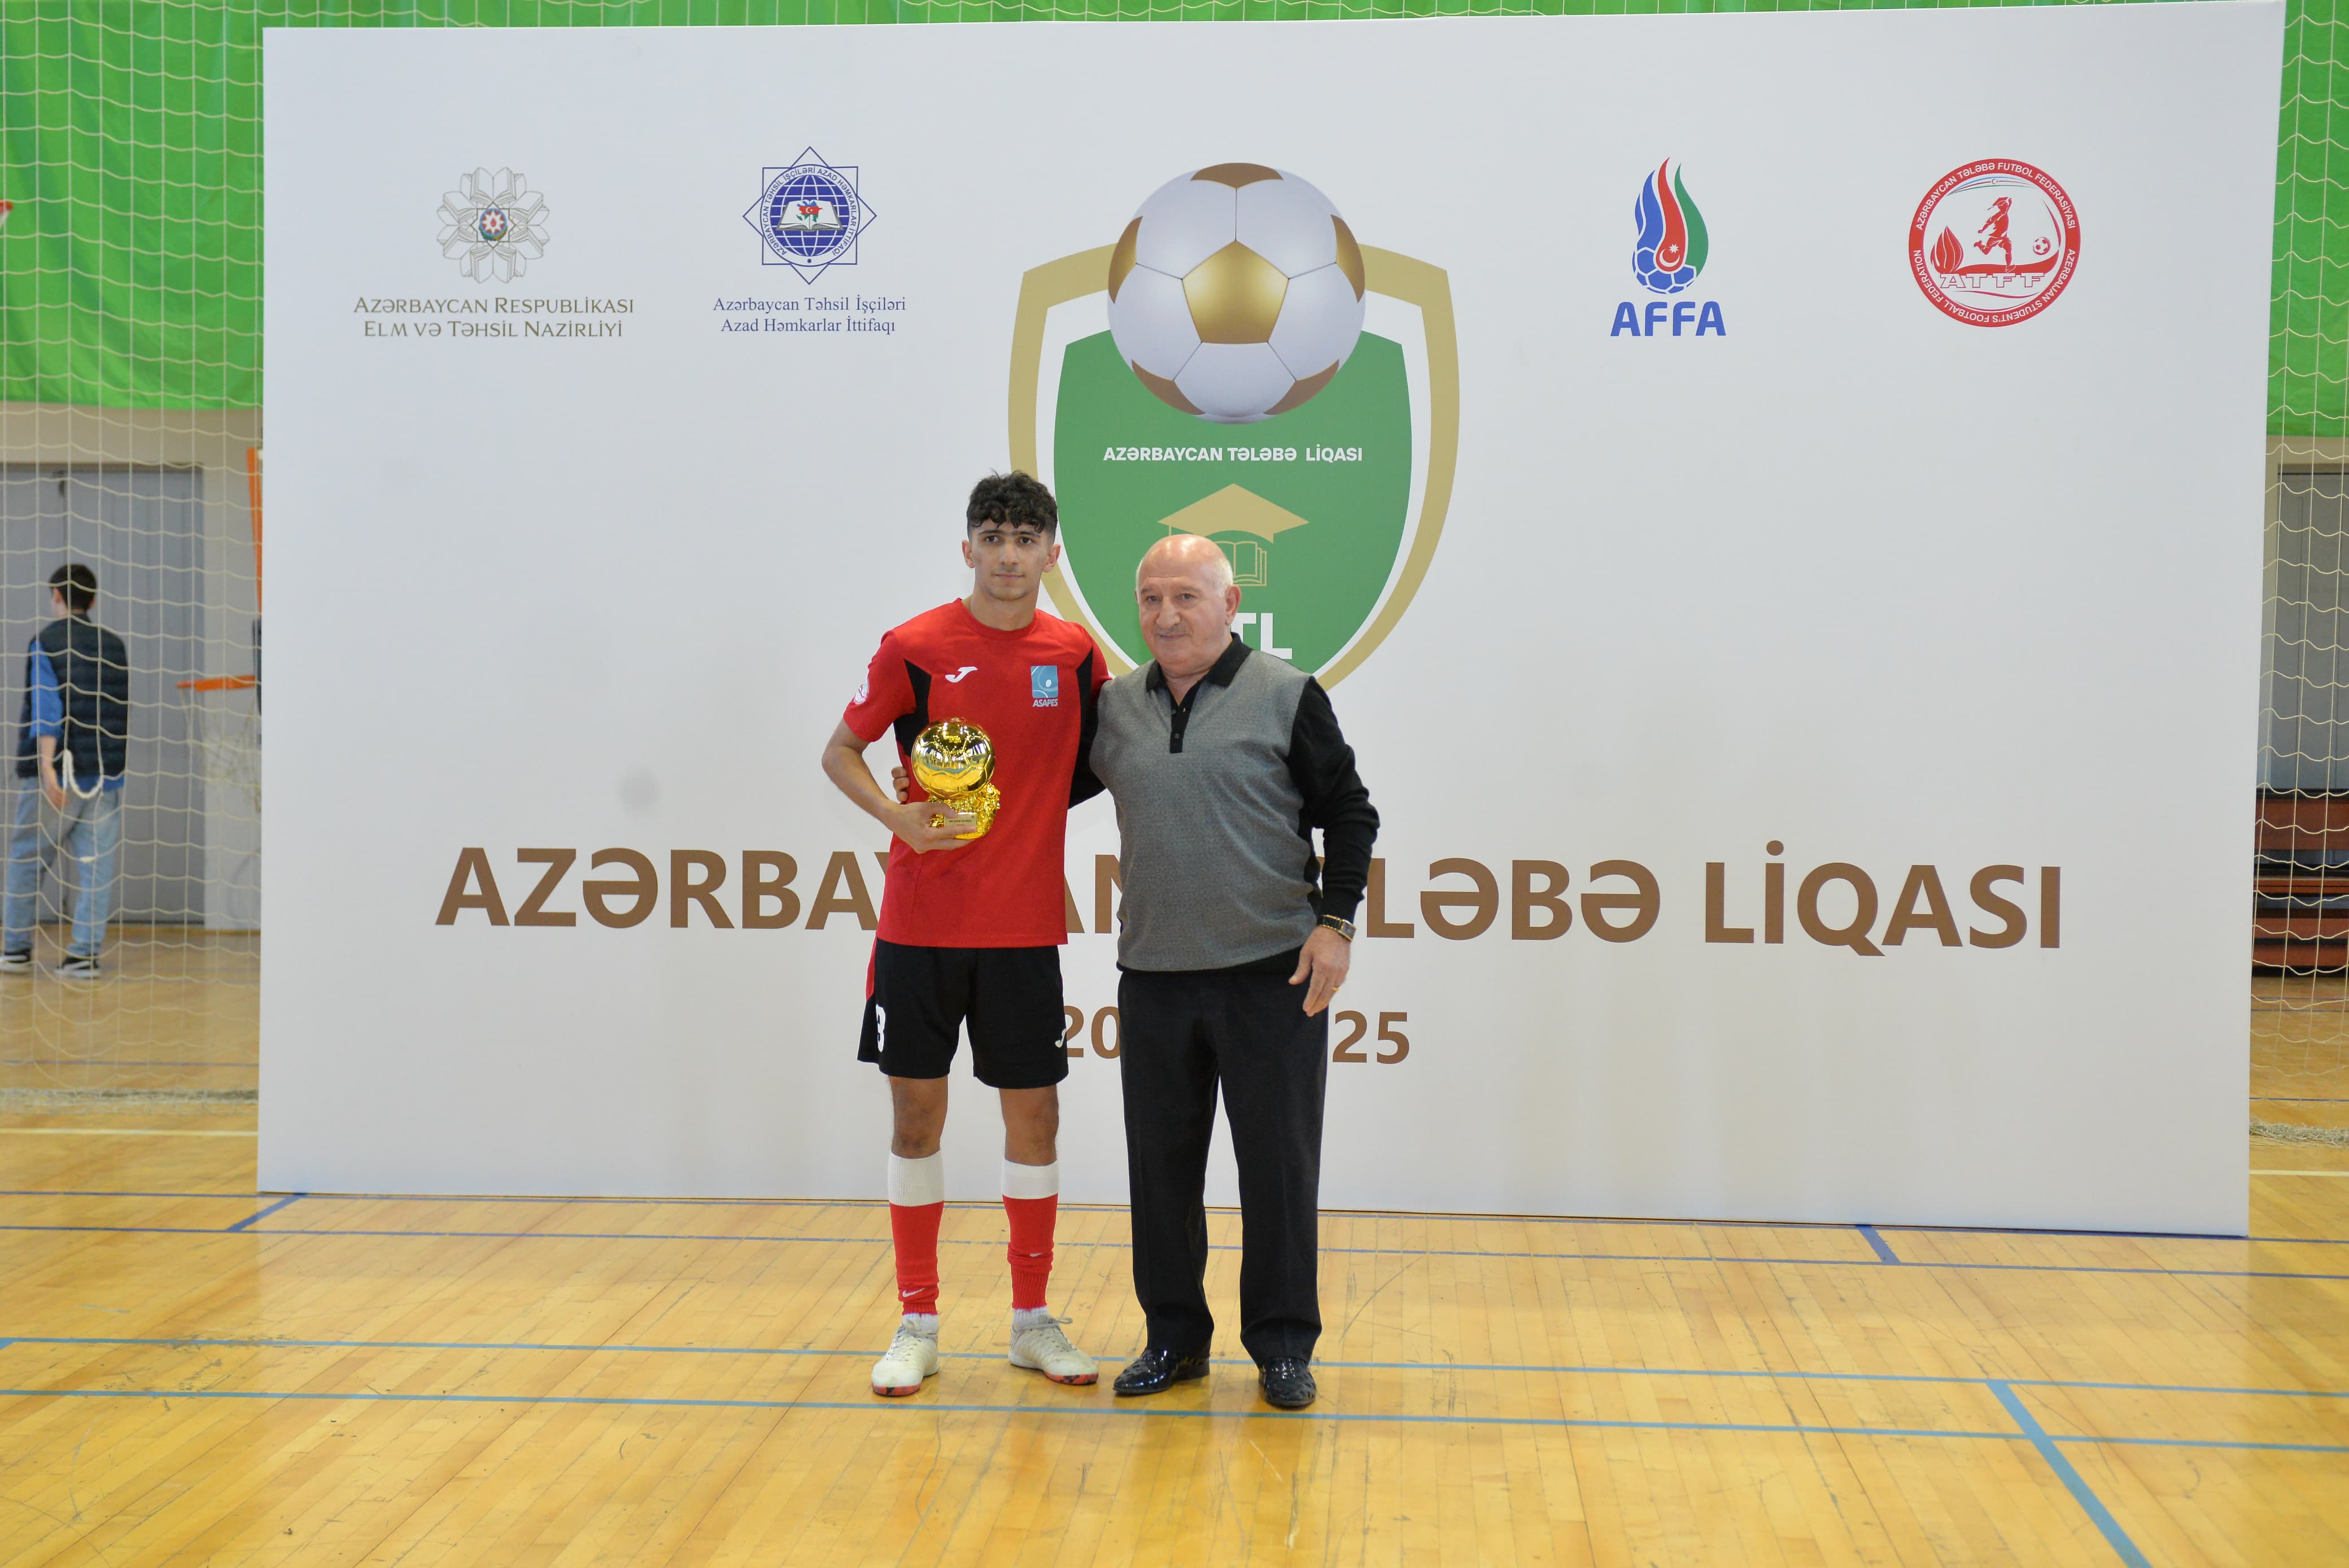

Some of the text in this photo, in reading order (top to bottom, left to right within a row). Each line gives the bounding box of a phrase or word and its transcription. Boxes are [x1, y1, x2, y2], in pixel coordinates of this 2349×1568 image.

[1916, 163, 2075, 230] AZƏRBAYCAN TƏLƏBƏ FUTBOL FEDERASİYASI
[763, 167, 857, 256] AZƏRBAYCAN TƏHSİL İŞÇİLƏRİ AZAD HƏMKARLAR İTTİFAQI
[1914, 249, 2075, 322] AZERBAIJAN STUDENT'S FOOTBALL FEDERATION
[1940, 273, 2045, 289] ATFF
[354, 296, 633, 313] AZƏRBAYCAN RESPUBLİKASI
[713, 295, 905, 314] Azərbaycan Təhsil İşçiləri
[365, 320, 622, 337] ELM VƏ TƏHSİL NAZİRLİYİ
[721, 316, 894, 335] Azad Həmkarlar İttifaqı
[1610, 301, 1726, 337] AFFA
[1103, 444, 1362, 462] AZƏRBAYCAN TƏLƏBƏ LİQASI
[1705, 840, 2058, 955] LİQASI
